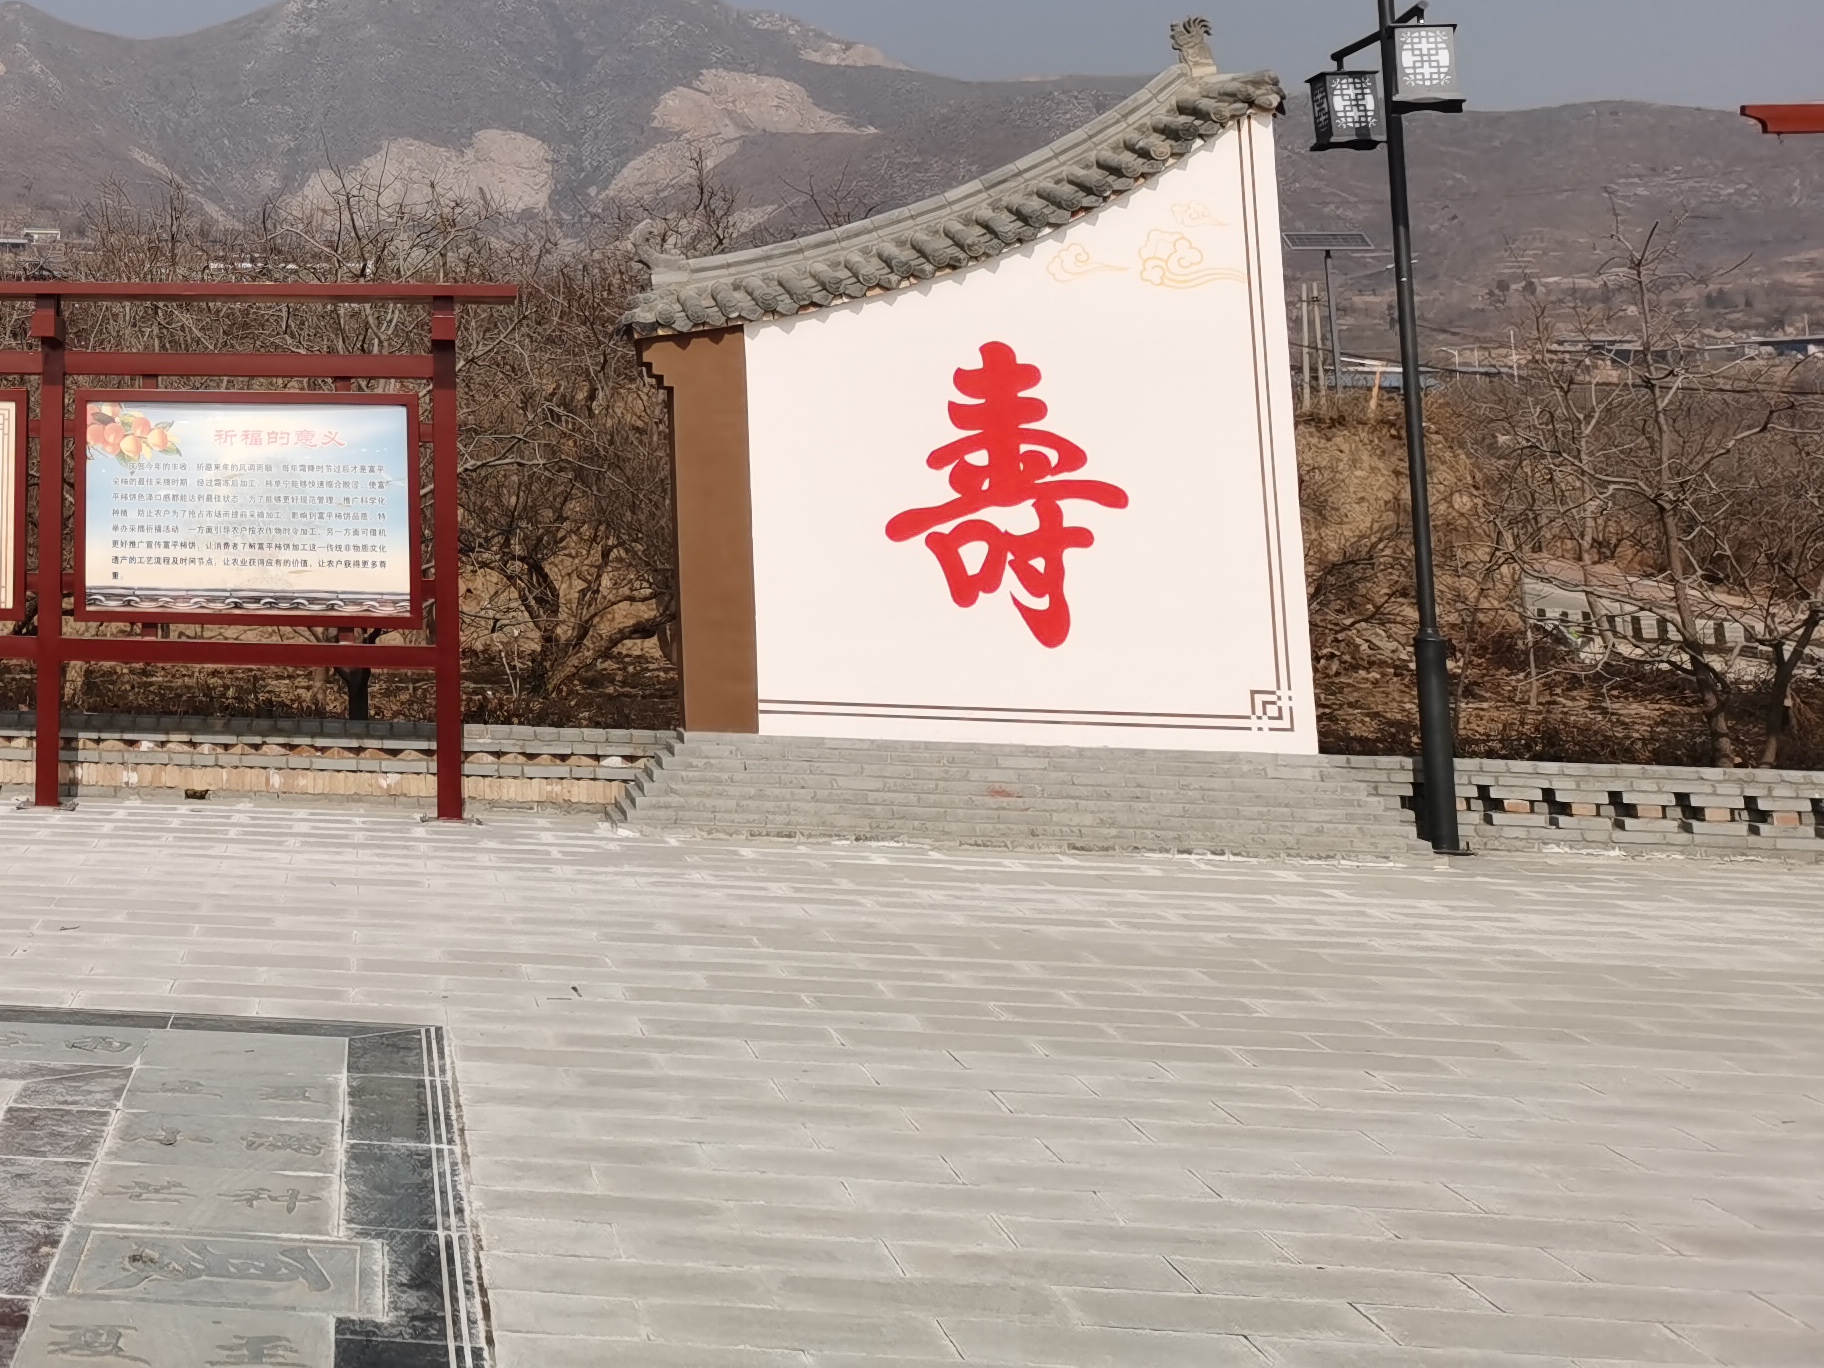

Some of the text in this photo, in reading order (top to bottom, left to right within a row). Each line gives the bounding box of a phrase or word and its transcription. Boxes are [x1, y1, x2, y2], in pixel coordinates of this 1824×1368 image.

[213, 428, 347, 450] 祈福的意义
[885, 340, 1129, 649] 寿
